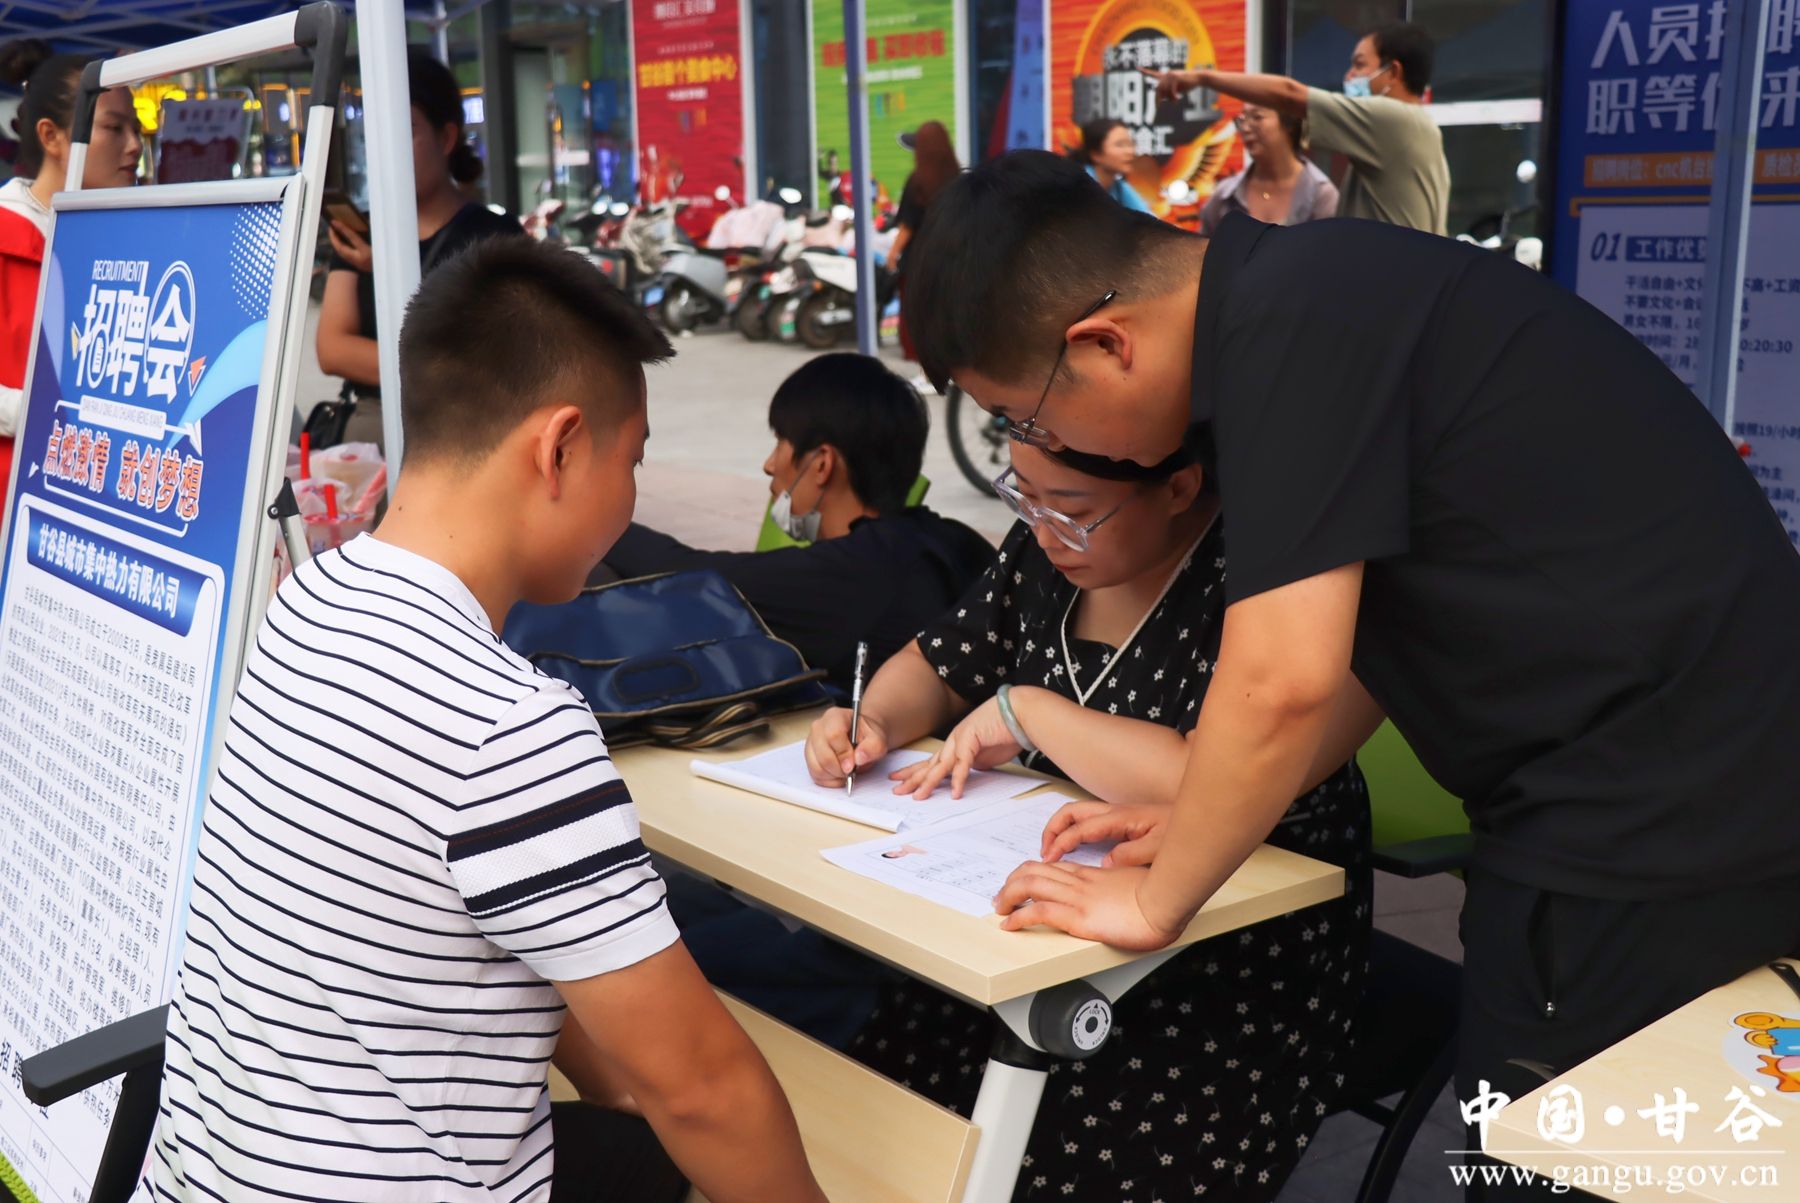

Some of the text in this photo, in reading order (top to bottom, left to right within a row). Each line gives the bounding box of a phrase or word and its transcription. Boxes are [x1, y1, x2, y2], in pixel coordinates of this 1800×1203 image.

[92, 260, 143, 283] RECRUITMENT
[1590, 232, 1622, 261] 01
[76, 261, 196, 404] 招聘会
[43, 419, 111, 494] 点燃激情
[37, 522, 181, 619] 甘谷县城市集中热力有限公司
